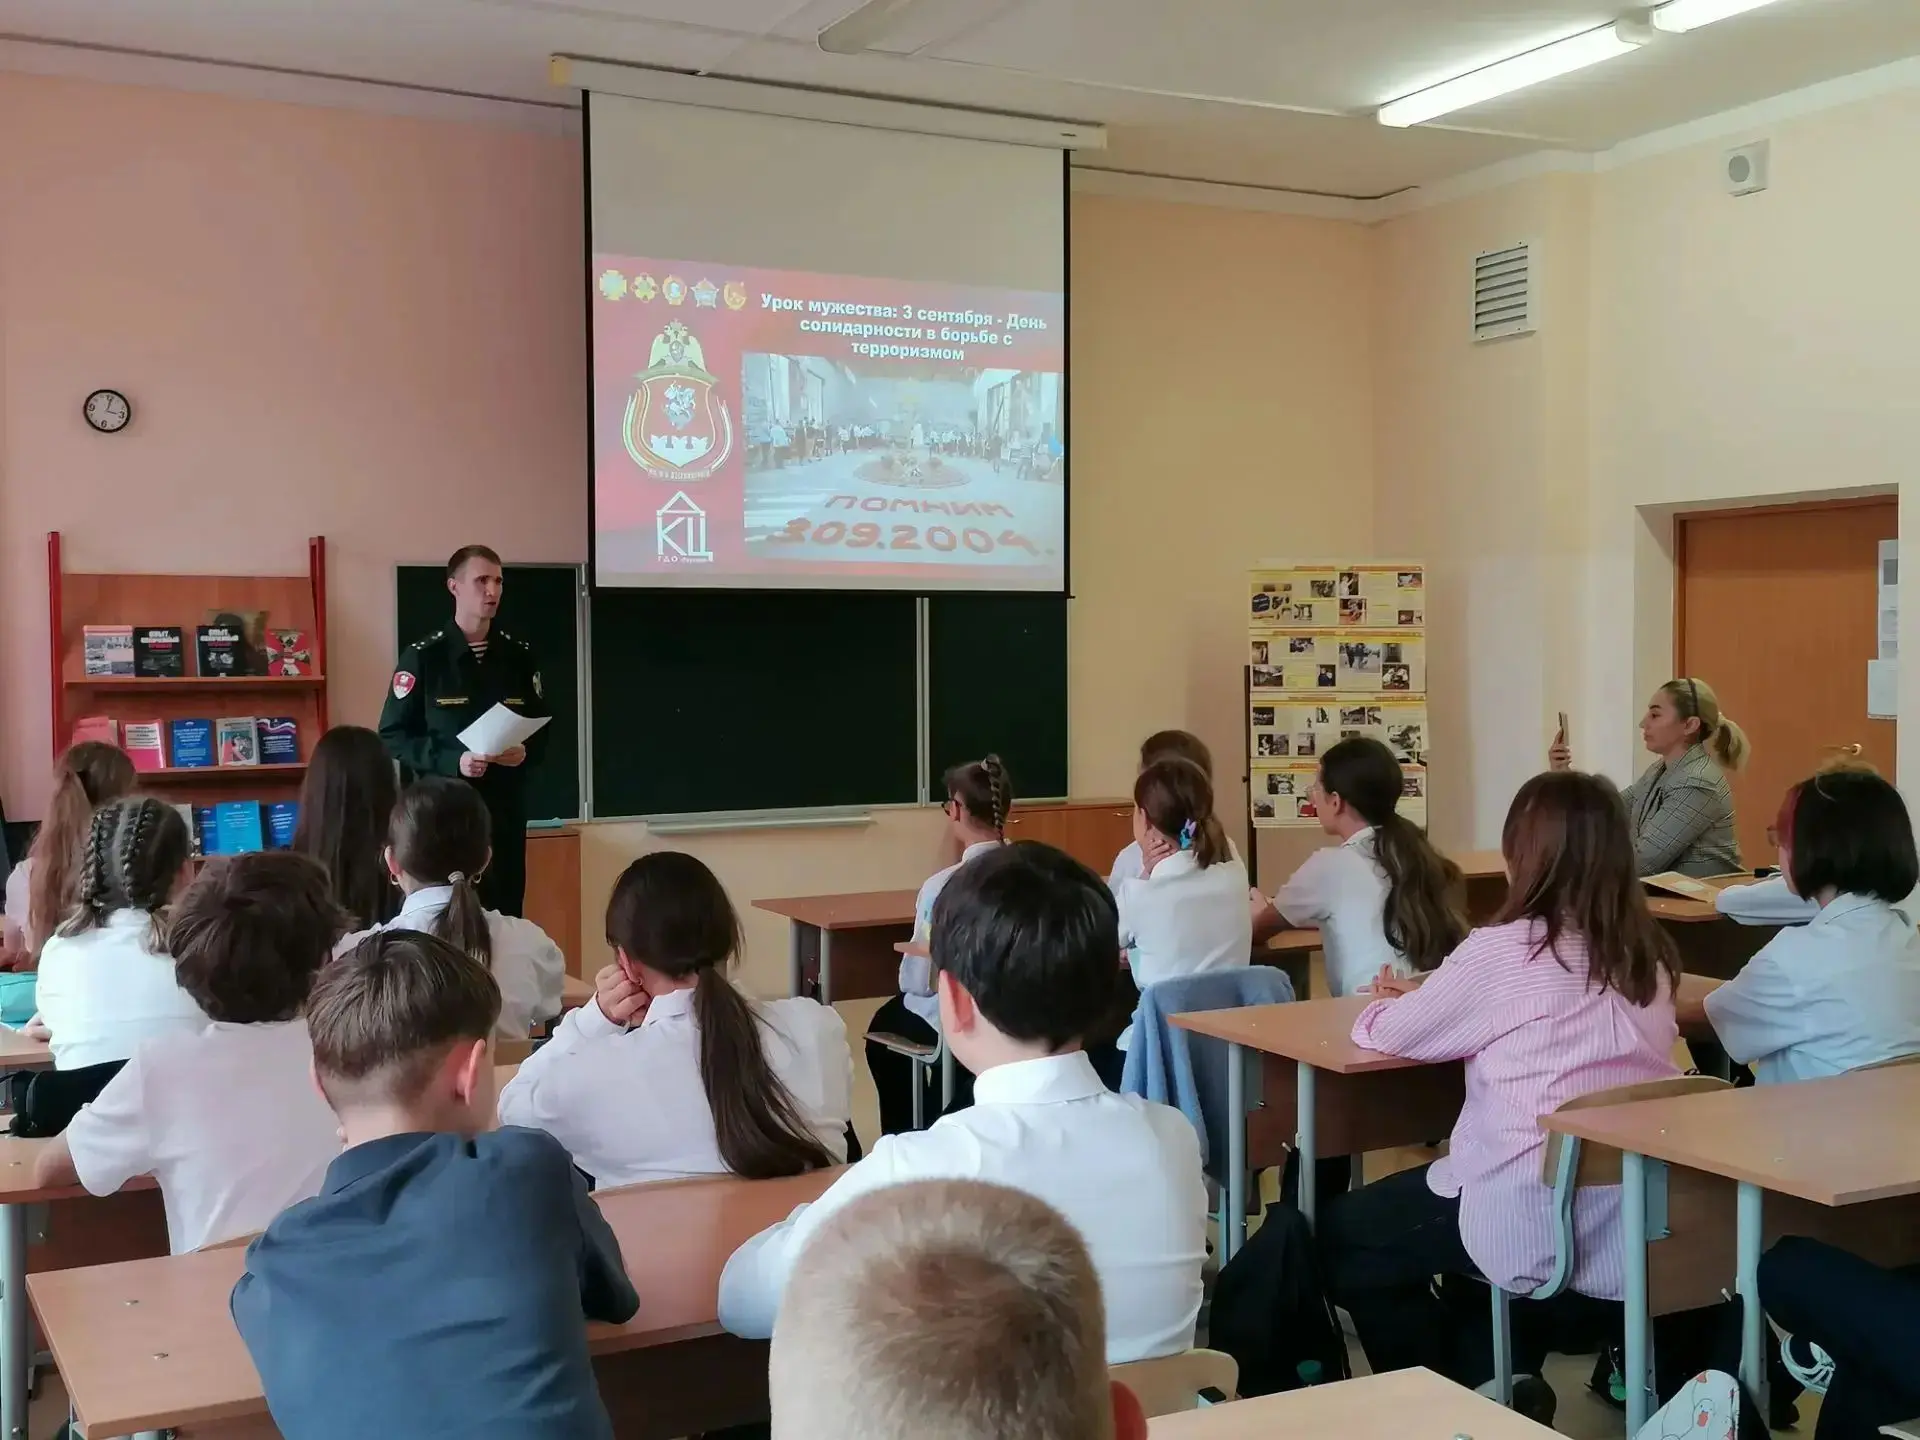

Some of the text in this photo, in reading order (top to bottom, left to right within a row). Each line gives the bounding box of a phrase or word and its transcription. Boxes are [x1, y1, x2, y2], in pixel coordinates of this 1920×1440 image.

[761, 293, 803, 312] Урок
[808, 300, 898, 317] мужества:
[902, 304, 913, 319] 3
[917, 308, 993, 327] сентября
[1006, 313, 1048, 330] День
[800, 319, 1013, 345] солидарности в борьбе с
[851, 341, 965, 361] терроризмом
